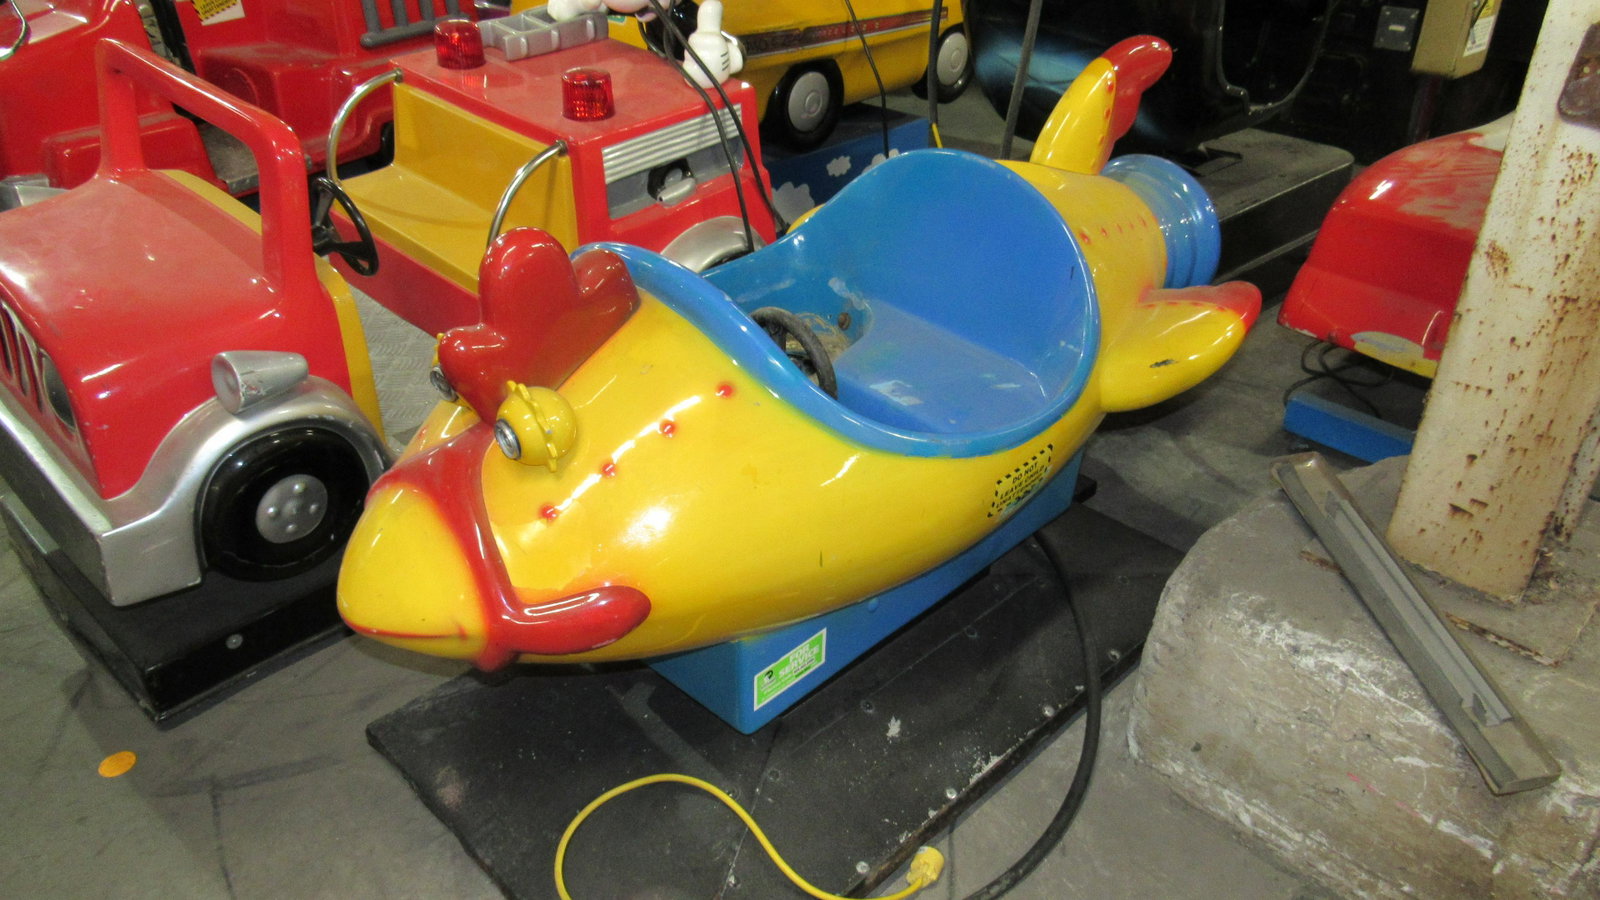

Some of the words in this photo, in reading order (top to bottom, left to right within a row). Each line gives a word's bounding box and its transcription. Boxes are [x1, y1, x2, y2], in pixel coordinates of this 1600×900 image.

[1000, 481, 1023, 500] LEAVE
[1025, 465, 1045, 483] CHILD
[1012, 473, 1023, 484] DO
[1024, 461, 1039, 476] NOT
[779, 644, 820, 678] SERVICE
